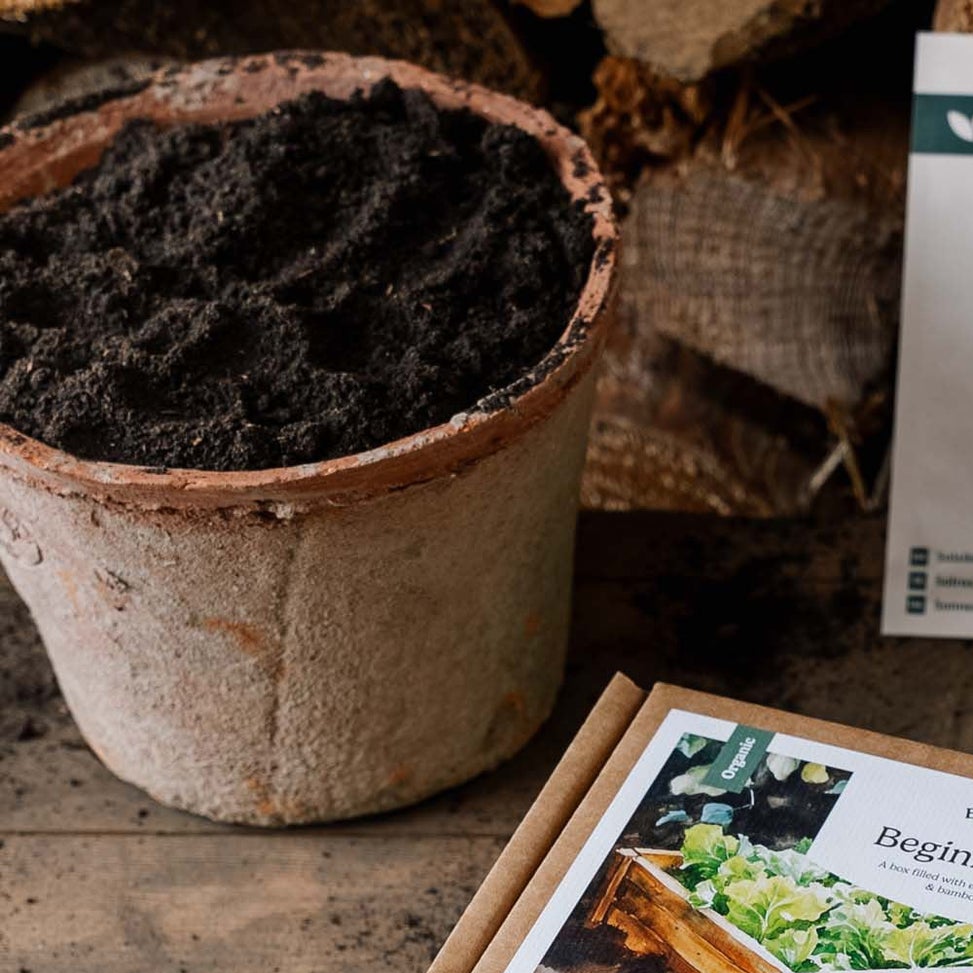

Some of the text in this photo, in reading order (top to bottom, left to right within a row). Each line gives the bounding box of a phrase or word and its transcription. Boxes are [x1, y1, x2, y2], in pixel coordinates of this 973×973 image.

[721, 737, 756, 780] Organic
[878, 861, 888, 869] A
[890, 862, 909, 875] box
[912, 868, 939, 881] filled
[942, 875, 966, 888] with
[925, 883, 935, 892] &
